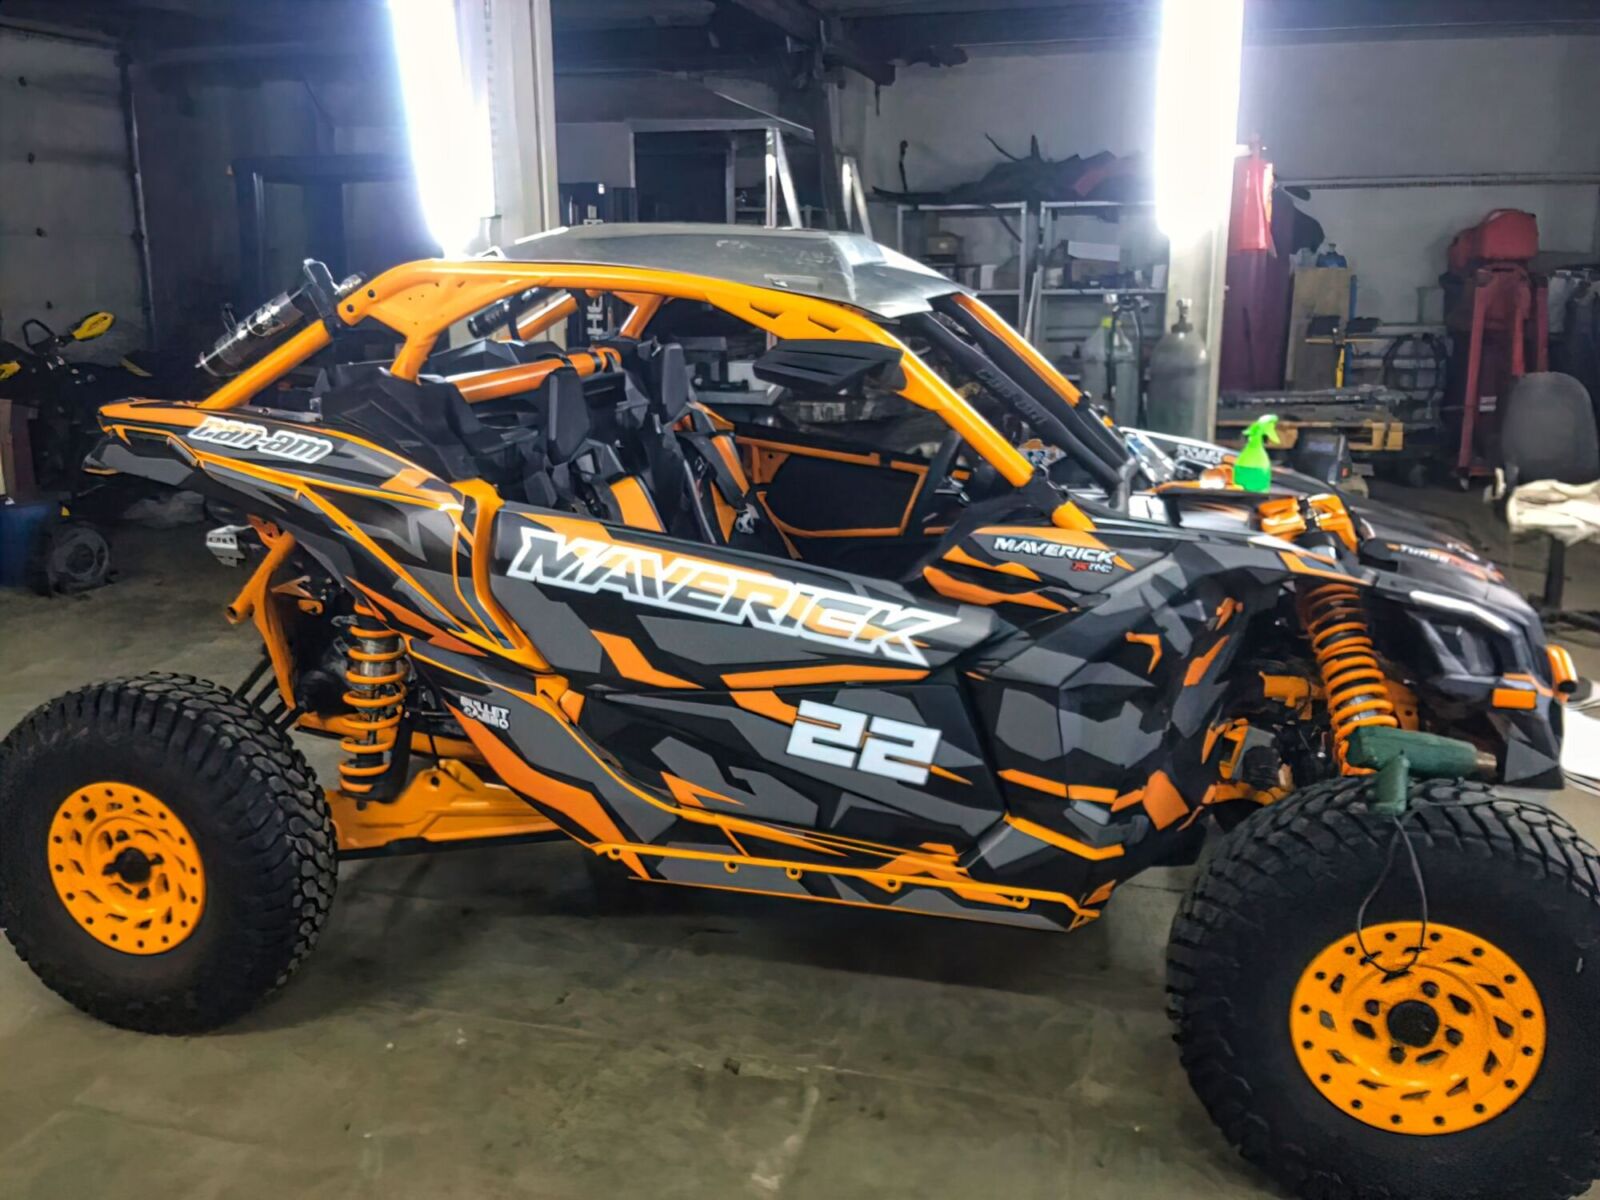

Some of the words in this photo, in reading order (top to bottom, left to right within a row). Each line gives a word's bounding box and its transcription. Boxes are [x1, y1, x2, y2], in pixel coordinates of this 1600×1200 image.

[994, 537, 1116, 564] MAVERICK
[507, 527, 961, 667] MAVERICK
[785, 699, 942, 786] 22
